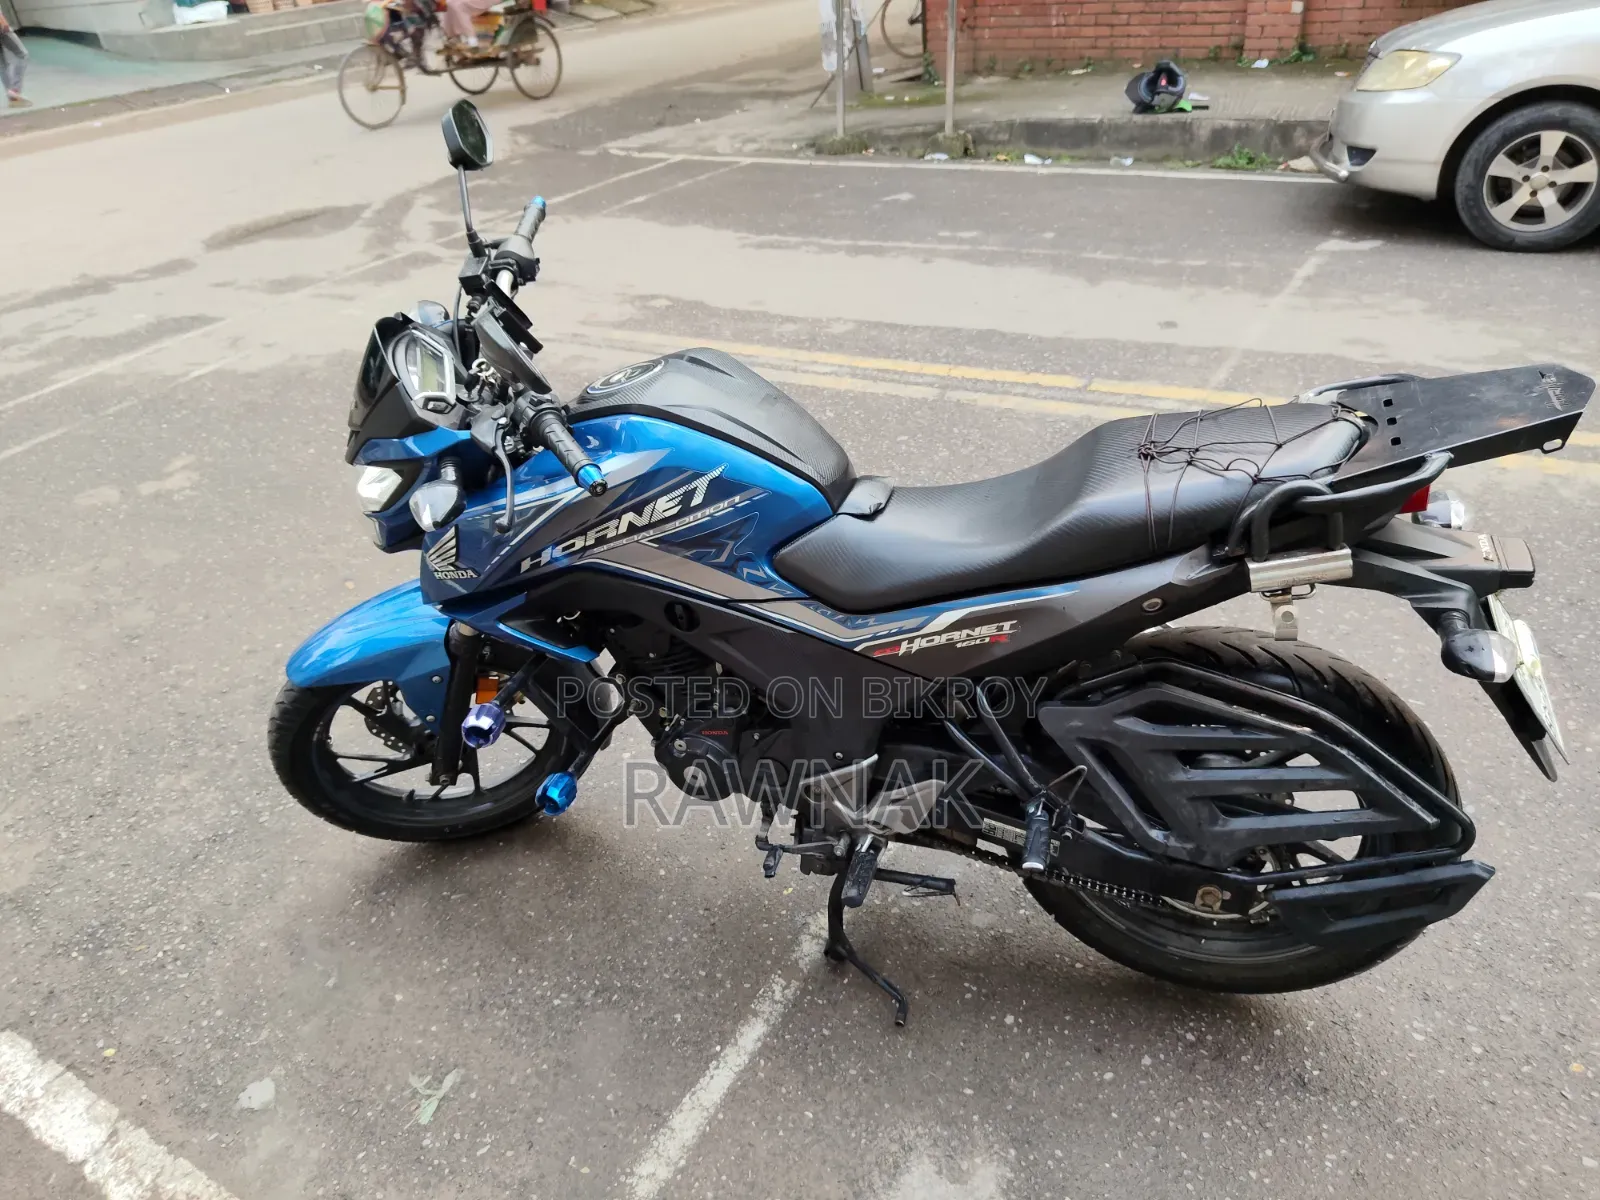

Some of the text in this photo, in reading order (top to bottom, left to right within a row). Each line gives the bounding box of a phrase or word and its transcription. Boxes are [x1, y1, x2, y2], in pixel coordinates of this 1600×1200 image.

[520, 463, 729, 574] HORNET
[593, 529, 662, 554] SPECIAL
[433, 569, 479, 580] HONDA
[898, 620, 1018, 657] HORNET
[955, 634, 1009, 648] 160R
